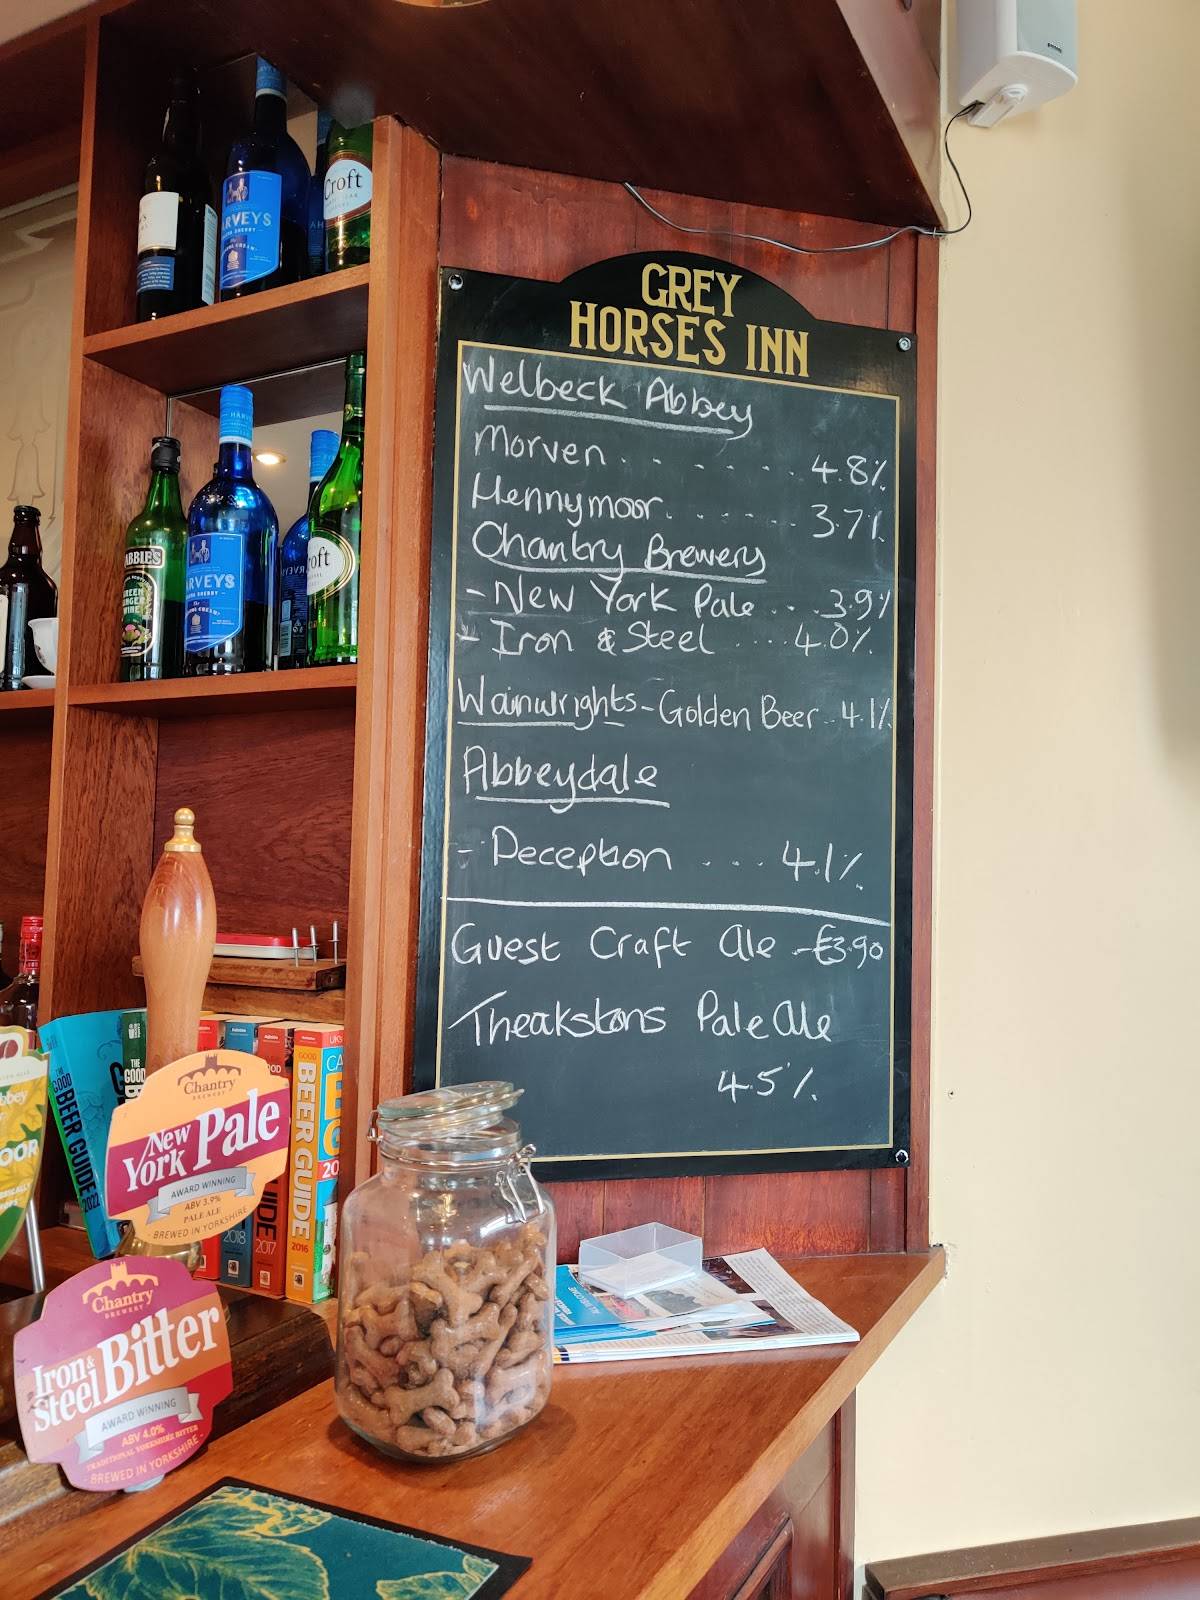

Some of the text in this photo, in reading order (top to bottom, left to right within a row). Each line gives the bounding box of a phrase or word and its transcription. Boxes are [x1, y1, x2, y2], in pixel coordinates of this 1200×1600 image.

[324, 168, 363, 201] Croft
[641, 262, 743, 317] GREY
[569, 300, 810, 377] HORSES INN
[463, 356, 753, 441] Welbeck Abbey
[474, 423, 888, 491] Morven 4.8%
[471, 473, 886, 543] Hennymoor 3.7%
[307, 546, 331, 570] roft
[471, 521, 767, 581] Chantry Brewery
[494, 576, 892, 620] New York Pale 3.9%
[491, 619, 873, 661] Iron & Steel 4.0%
[457, 675, 894, 732] Wainwrights Golden Beer 4.1%
[463, 745, 658, 814] Abbeydale
[492, 826, 865, 891] Deception 4.1%
[451, 922, 561, 966] Guest
[590, 925, 693, 969] Craft
[448, 990, 667, 1048] Theakstons
[697, 989, 769, 1040] Pale
[53, 1073, 73, 1093] GOOD
[124, 1068, 146, 1083] GOOD
[131, 1059, 141, 1067] THE
[717, 1062, 818, 1103] 4.5%
[184, 1077, 237, 1095] Chantry
[295, 1061, 317, 1144] BEER
[56, 1089, 97, 1197] BEER GUIDE
[148, 1123, 192, 1157] New
[193, 1088, 280, 1171] Pale
[122, 1149, 187, 1193] York
[171, 1174, 237, 1200] AWARD WINNING
[322, 1159, 340, 1178] 20
[83, 1193, 101, 1213] 2022
[183, 1206, 222, 1223] PALE ALE
[184, 1194, 222, 1211] ABV 3.9%
[291, 1148, 313, 1240] GUIDE
[153, 1230, 189, 1240] BREWED
[191, 1226, 201, 1236] IN
[203, 1207, 249, 1232] YORKSHIRE
[223, 1229, 246, 1245] 2018
[255, 1238, 277, 1255] 2017
[291, 1242, 309, 1254] 2016
[91, 1288, 154, 1314] Chantry
[104, 1304, 144, 1320] BREWERY
[96, 1307, 221, 1405] Bitter
[32, 1354, 97, 1400] Iron &
[101, 1398, 178, 1433] AWARD WINNING
[121, 1423, 167, 1448] ABV 4.0%
[89, 1434, 200, 1485] BREWED IN YORKSHIRE
